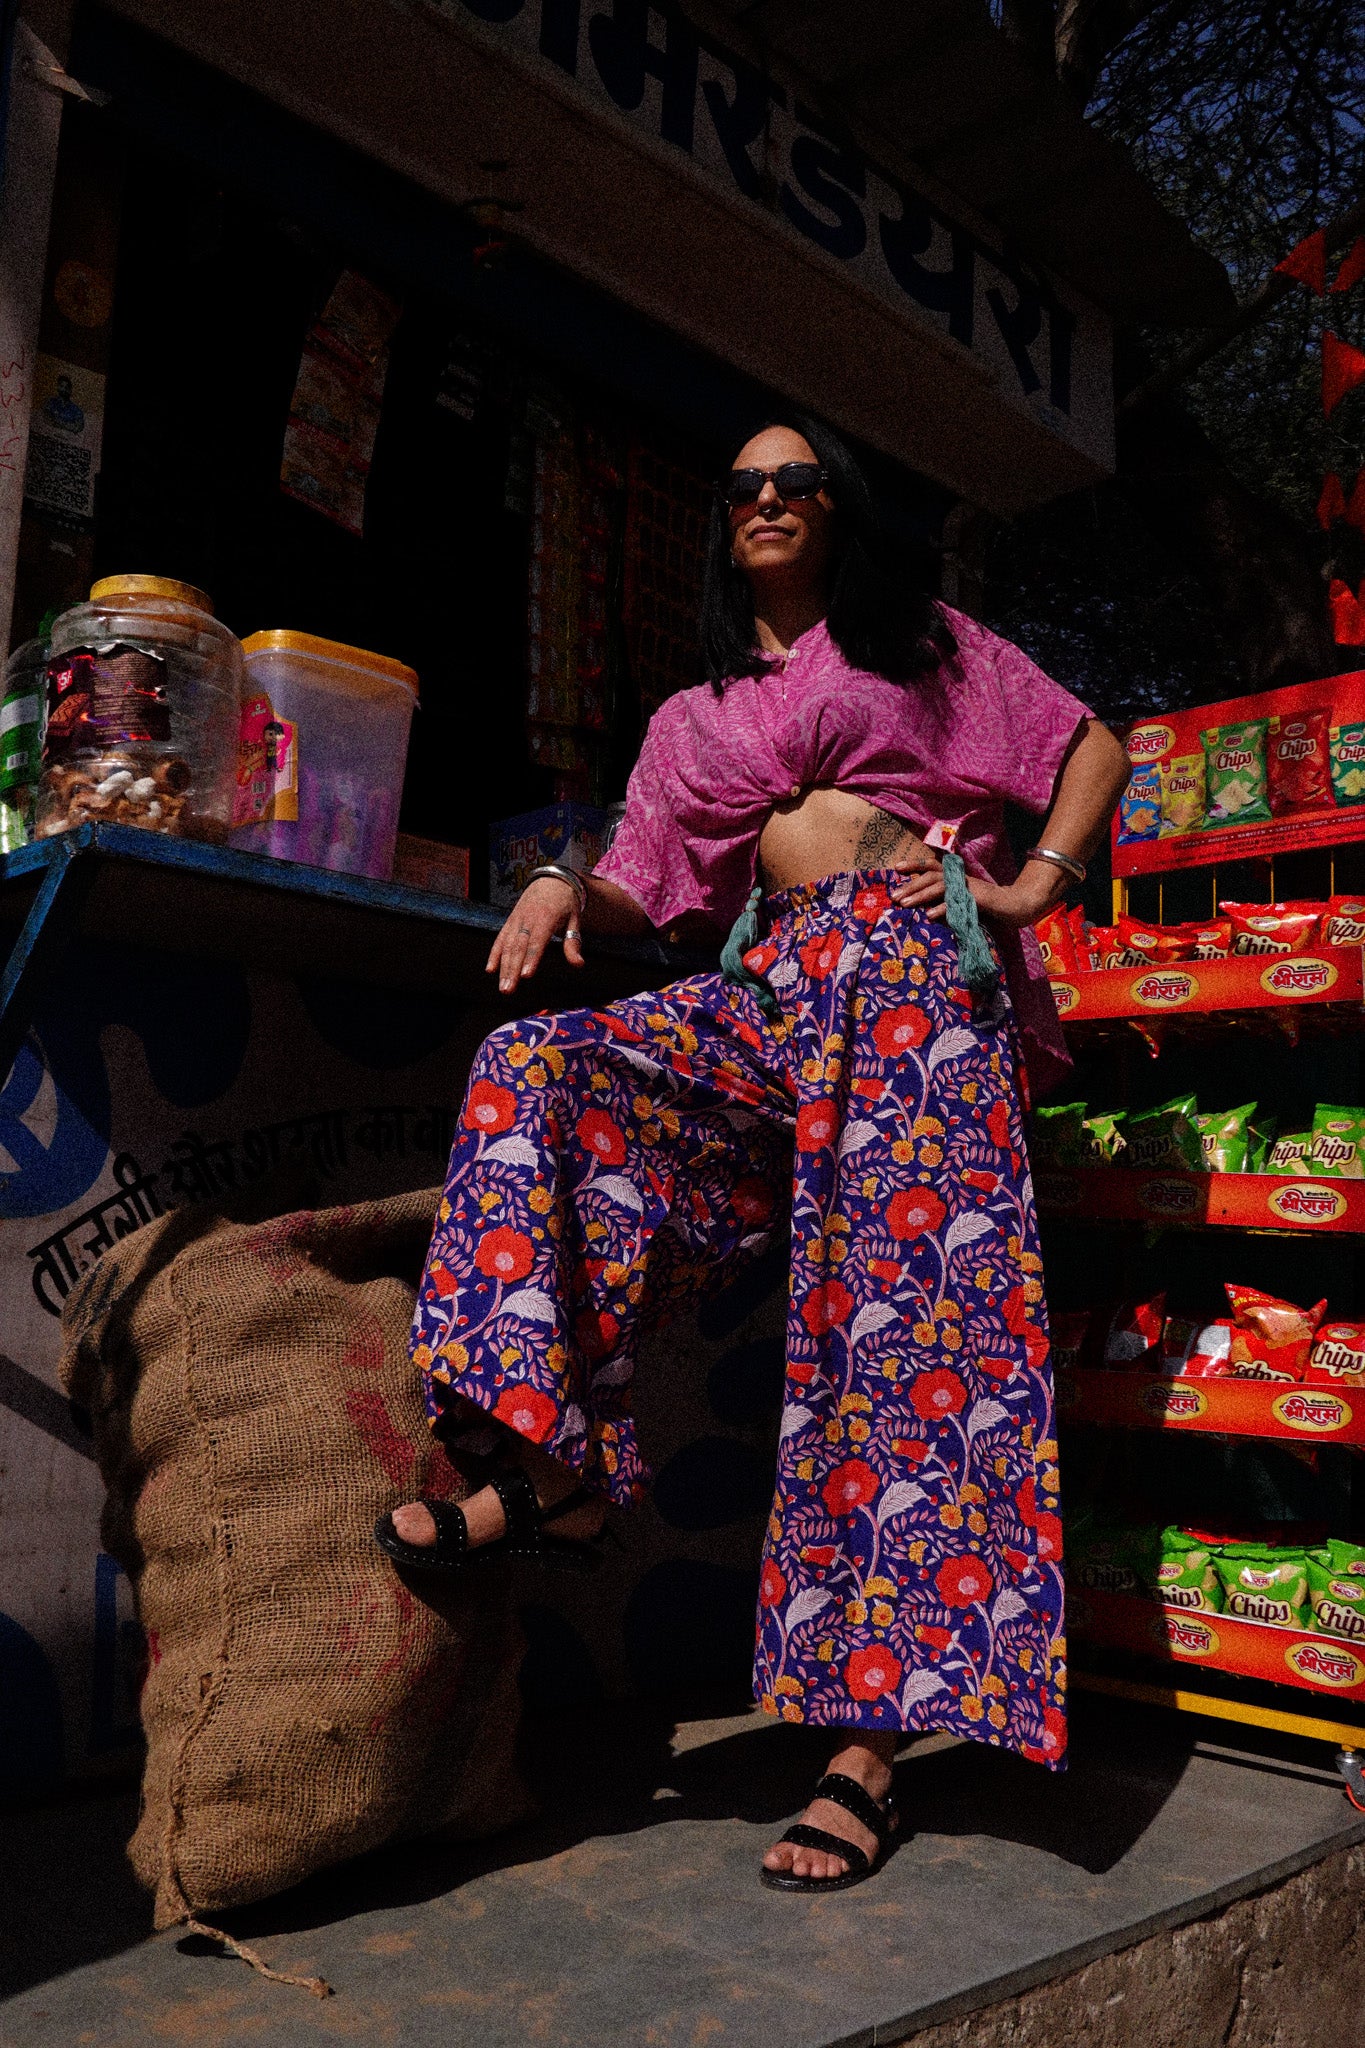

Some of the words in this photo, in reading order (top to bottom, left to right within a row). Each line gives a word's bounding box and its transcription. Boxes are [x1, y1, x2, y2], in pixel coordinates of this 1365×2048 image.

[1125, 732, 1169, 756] श्रीराम
[1278, 740, 1316, 761] Chips
[1217, 750, 1253, 771] Chips
[1127, 785, 1156, 801] Chips
[1169, 778, 1197, 794] Chips
[499, 835, 539, 866] king
[1137, 977, 1190, 1001] श्रीराम
[1268, 965, 1329, 990] श्रीराम
[355, 1105, 417, 1162] का
[1273, 1141, 1304, 1166] hips
[1313, 1135, 1355, 1166] Chips
[1275, 1188, 1338, 1218] श्रीराम
[1313, 1341, 1364, 1375] Chips
[1146, 1385, 1200, 1416] श्रीराम
[1280, 1395, 1344, 1427] श्रीराम
[1230, 1595, 1289, 1623] Chips
[1292, 1645, 1358, 1682] श्रीराम
